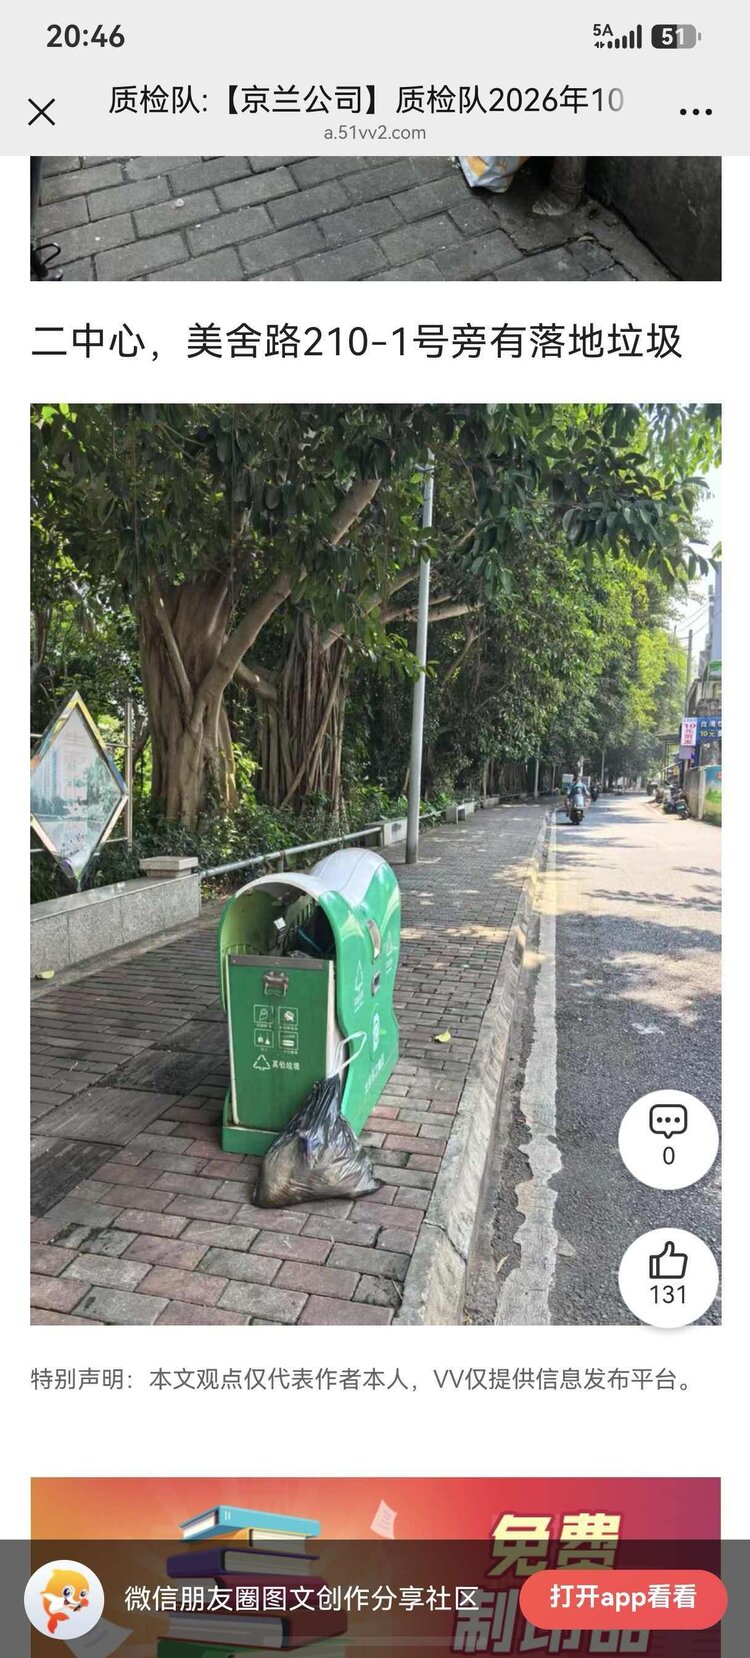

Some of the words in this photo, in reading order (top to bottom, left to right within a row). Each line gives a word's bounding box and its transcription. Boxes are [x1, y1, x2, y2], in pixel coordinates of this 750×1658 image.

[46, 23, 125, 48] 20:46
[592, 23, 614, 37] 5A
[661, 27, 684, 46] 51
[323, 124, 426, 140] a.51vv2.com
[662, 1146, 675, 1166] 0
[650, 1284, 685, 1304] 131
[488, 1512, 621, 1576] 免费
[124, 1584, 480, 1612] 微信朋友圈图文创作分享社区
[549, 1583, 697, 1612] 打开app看看
